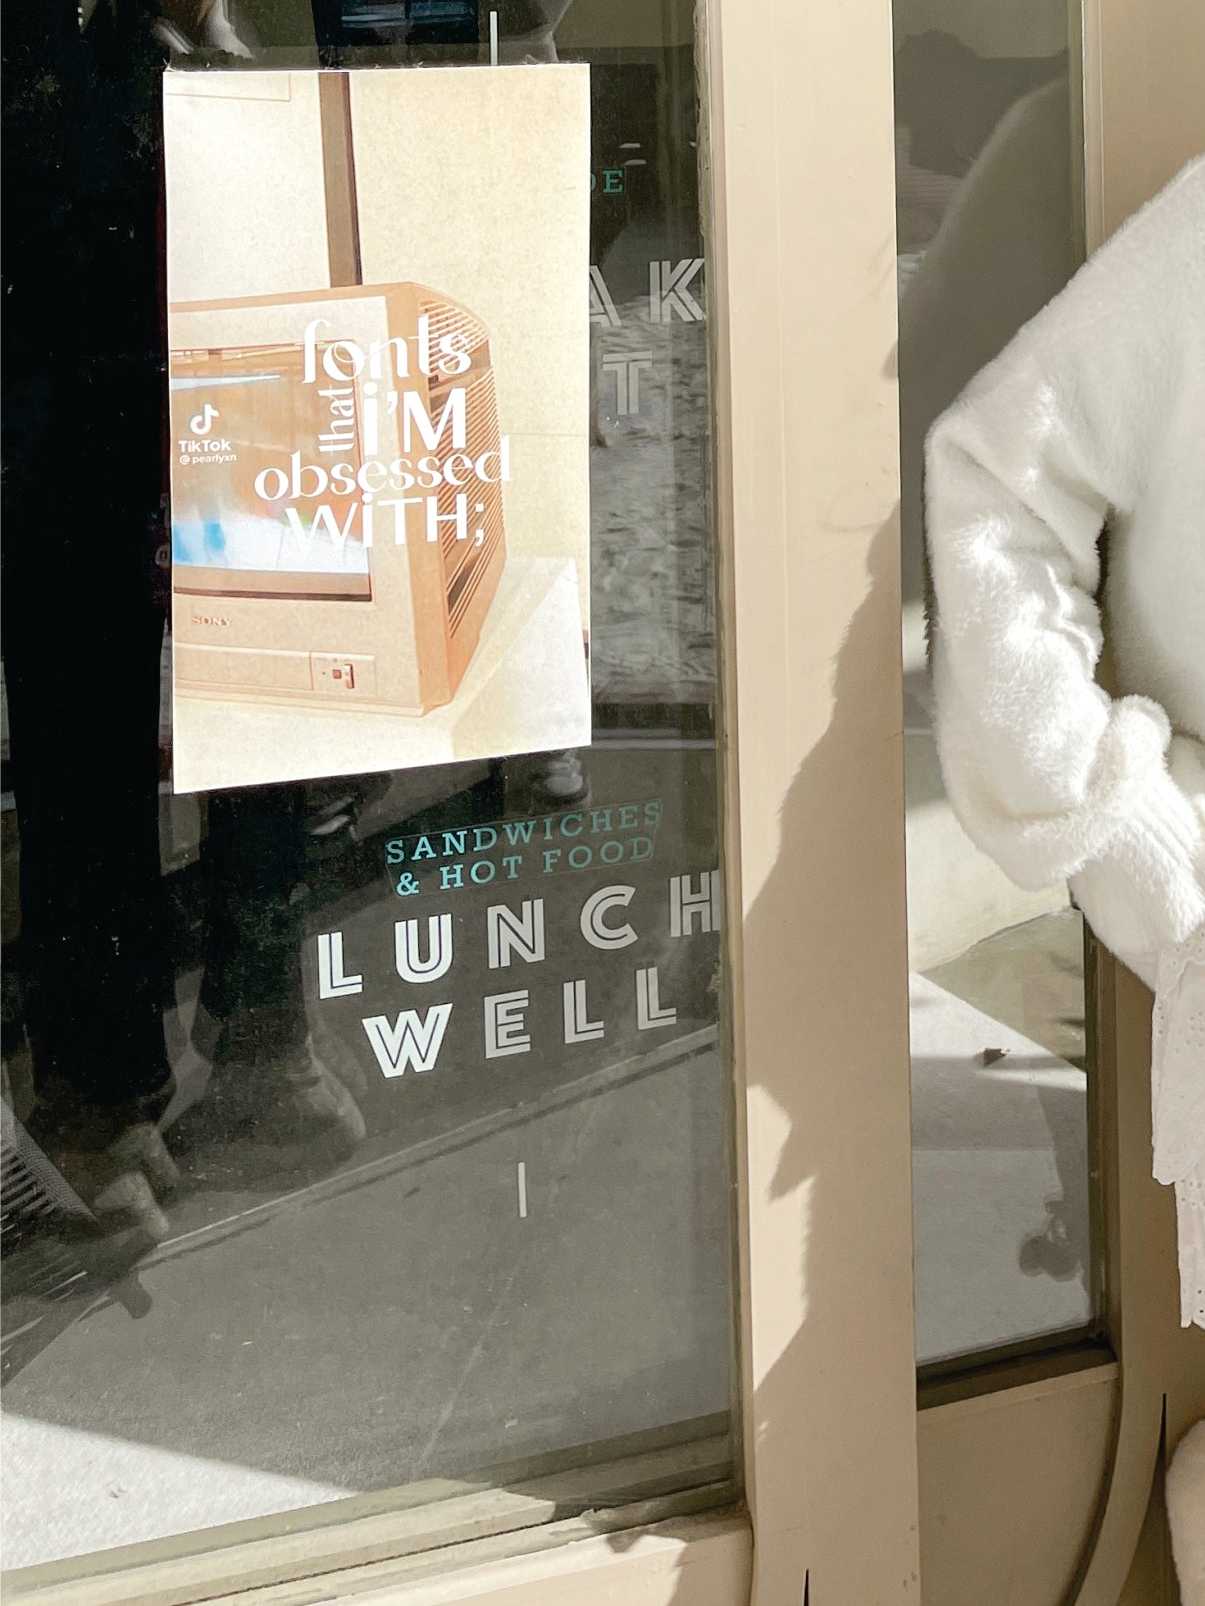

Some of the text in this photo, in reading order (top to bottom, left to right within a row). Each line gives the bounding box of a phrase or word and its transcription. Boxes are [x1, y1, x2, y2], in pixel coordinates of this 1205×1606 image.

[301, 314, 472, 384] fonts
[178, 438, 232, 453] TikTok
[318, 384, 355, 455] that
[254, 435, 512, 501] obsessed
[191, 615, 231, 627] SONY
[385, 801, 662, 865] SANDWICHES
[396, 836, 655, 897] & HOT FOOD
[317, 869, 721, 1000] LUNCH
[362, 967, 677, 1079] WELL
